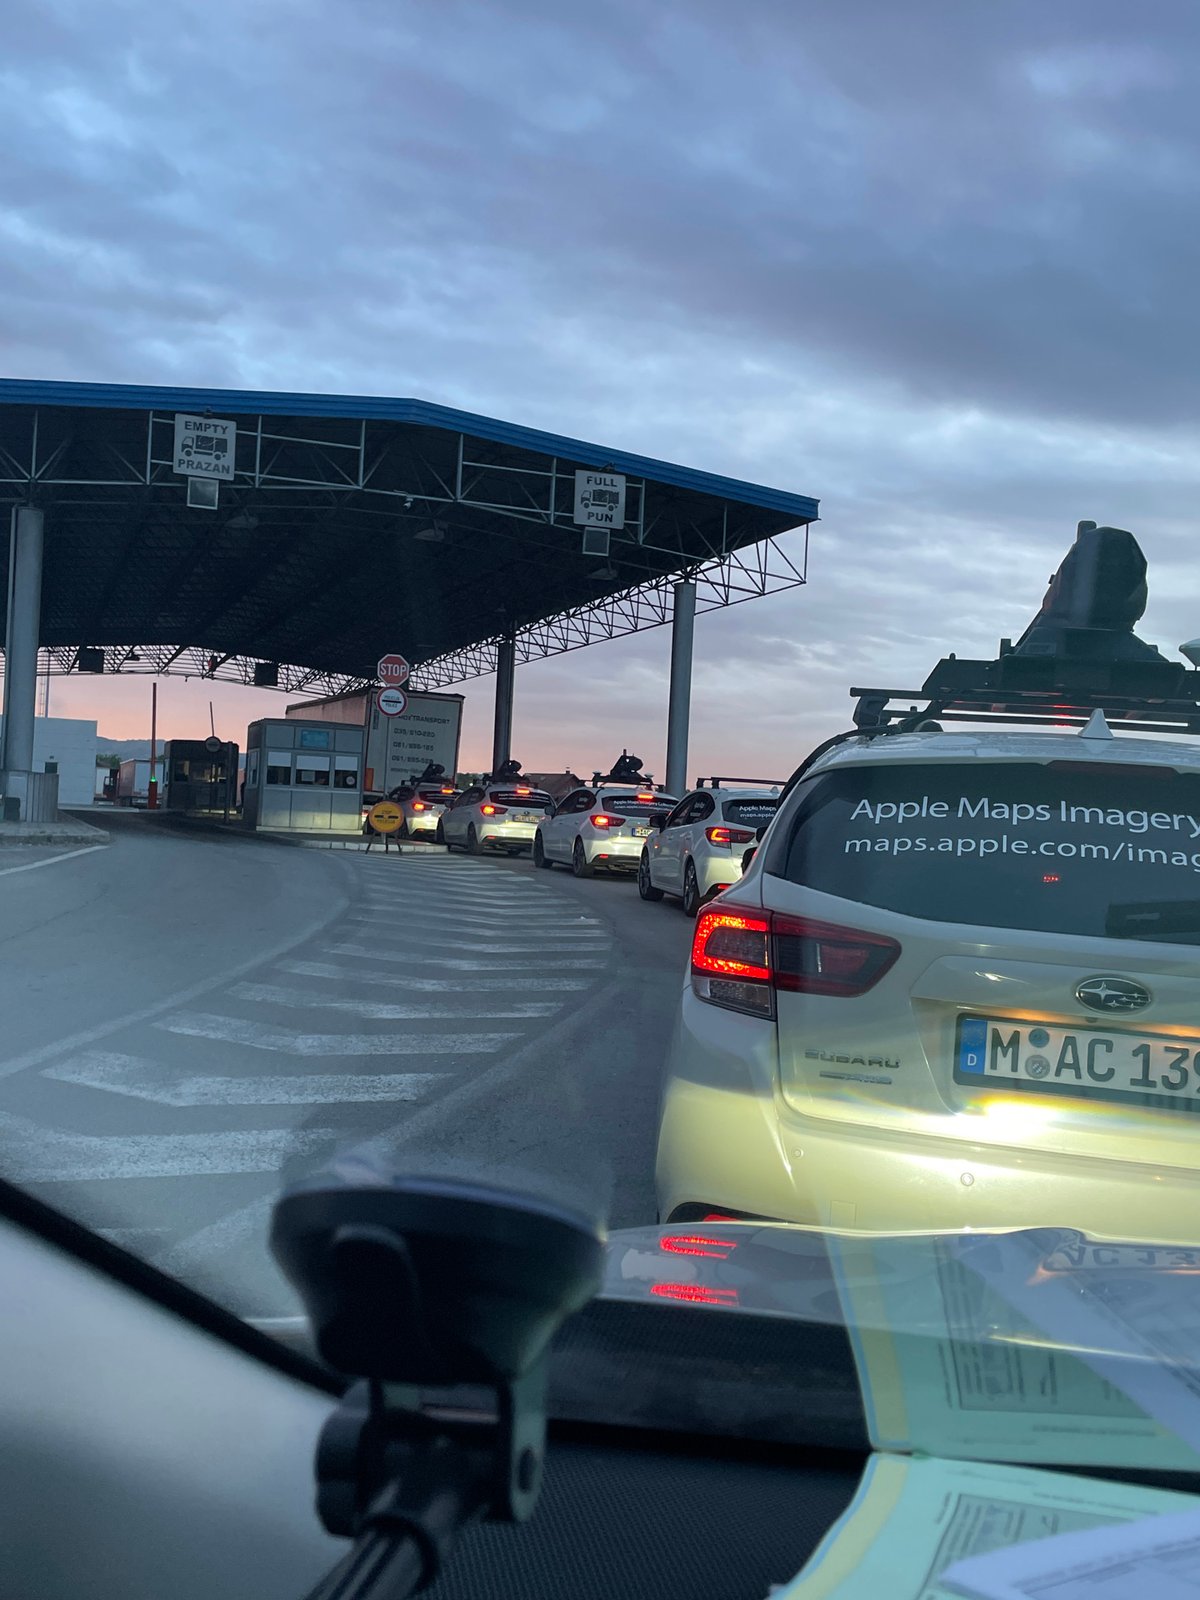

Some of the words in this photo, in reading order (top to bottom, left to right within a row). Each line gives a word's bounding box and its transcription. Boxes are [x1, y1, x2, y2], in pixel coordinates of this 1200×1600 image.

[184, 421, 228, 434] EMPTY
[177, 459, 230, 474] PRAZAN
[586, 476, 618, 487] FULL
[587, 512, 613, 523] PUN
[380, 663, 407, 676] STOP
[850, 796, 949, 824] Apple
[957, 797, 1051, 825] Maps
[1060, 800, 1200, 839] Imagery
[804, 1049, 901, 1069] SUBARU
[967, 1053, 977, 1066] D
[990, 1027, 1020, 1073] M
[1054, 1035, 1116, 1082] AC
[1129, 1043, 1200, 1094] 13
